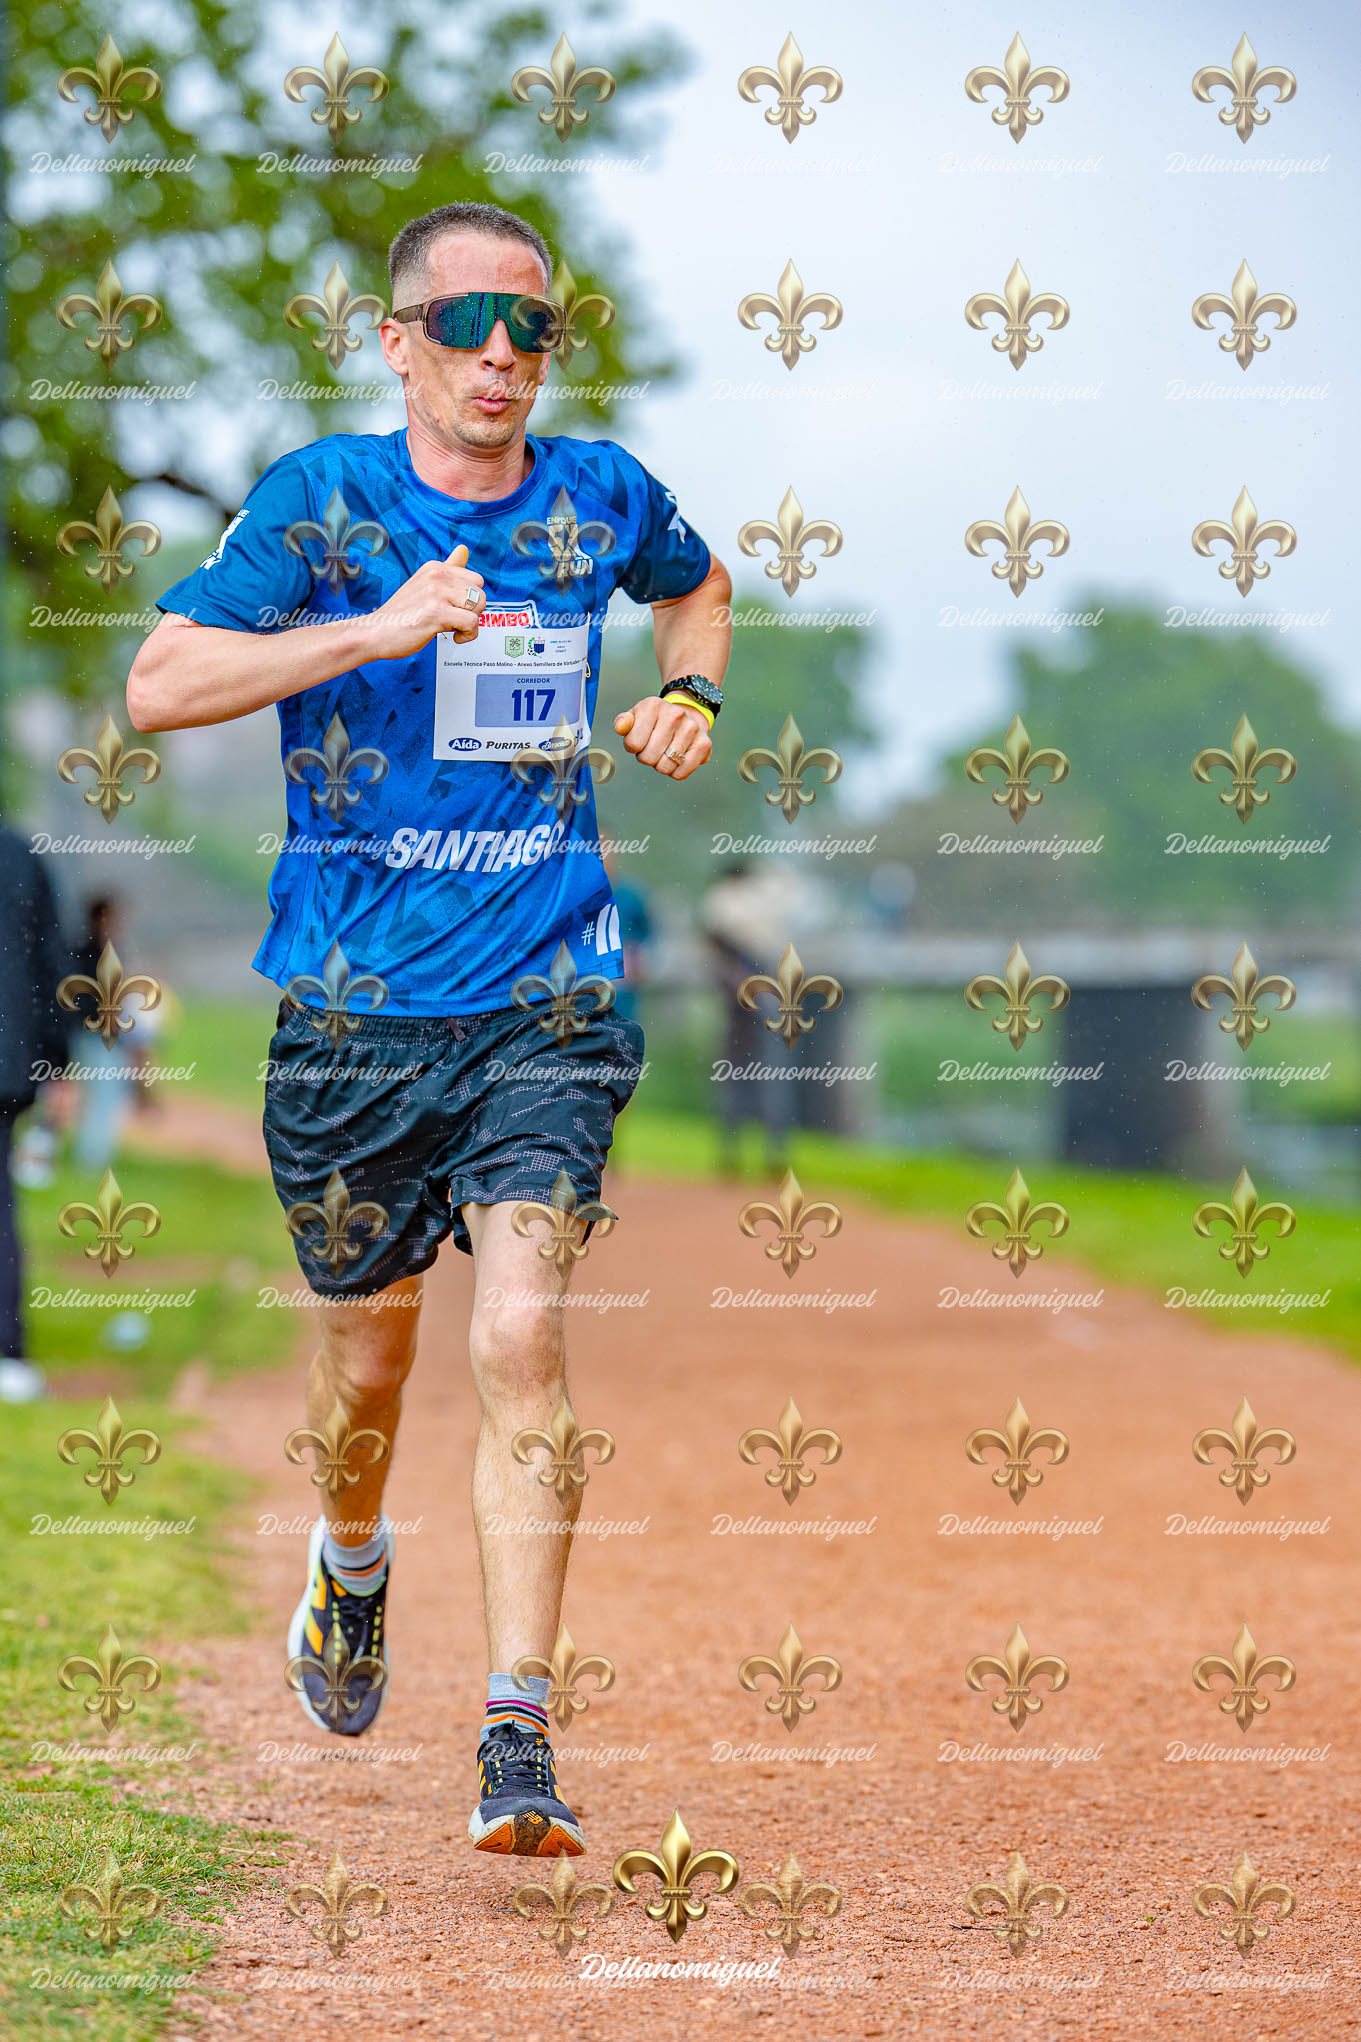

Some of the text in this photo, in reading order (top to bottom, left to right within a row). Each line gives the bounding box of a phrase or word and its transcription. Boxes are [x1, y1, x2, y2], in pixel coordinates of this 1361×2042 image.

[478, 612, 529, 627] BIMBO
[511, 689, 556, 722] 117
[385, 820, 565, 873] SANTIAGO
